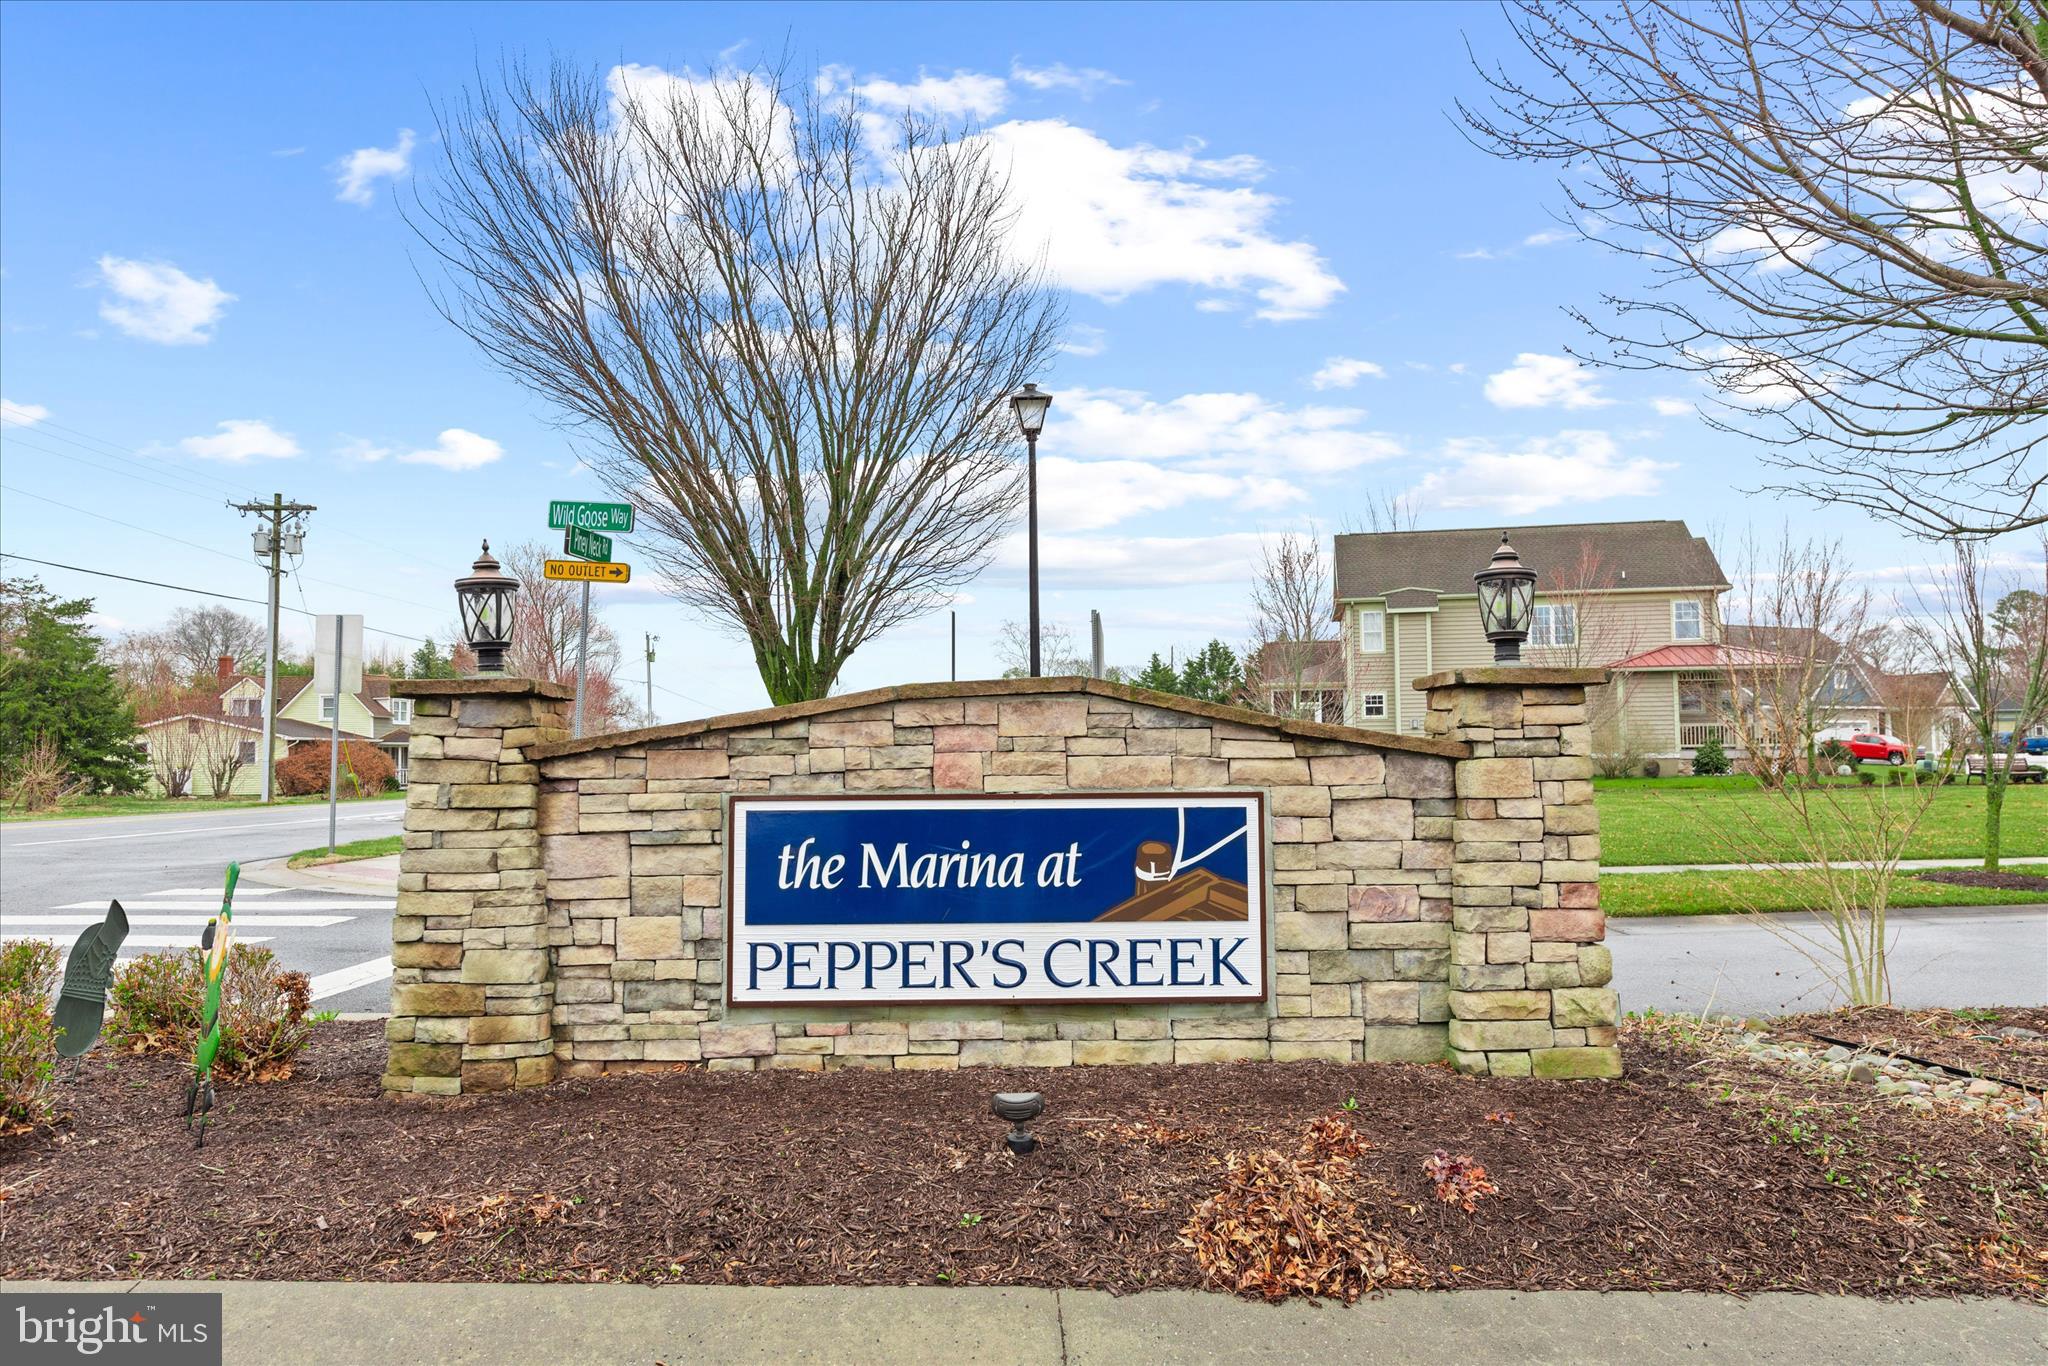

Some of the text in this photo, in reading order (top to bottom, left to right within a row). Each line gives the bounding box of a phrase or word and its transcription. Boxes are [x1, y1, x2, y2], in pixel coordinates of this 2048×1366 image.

[553, 504, 628, 528] Wild Goose Way
[574, 528, 609, 558] Piney Neck Rd
[550, 564, 606, 577] NO OUTLET
[778, 837, 1083, 890] the Marina at
[746, 937, 1253, 991] PEPPER'S CREEK
